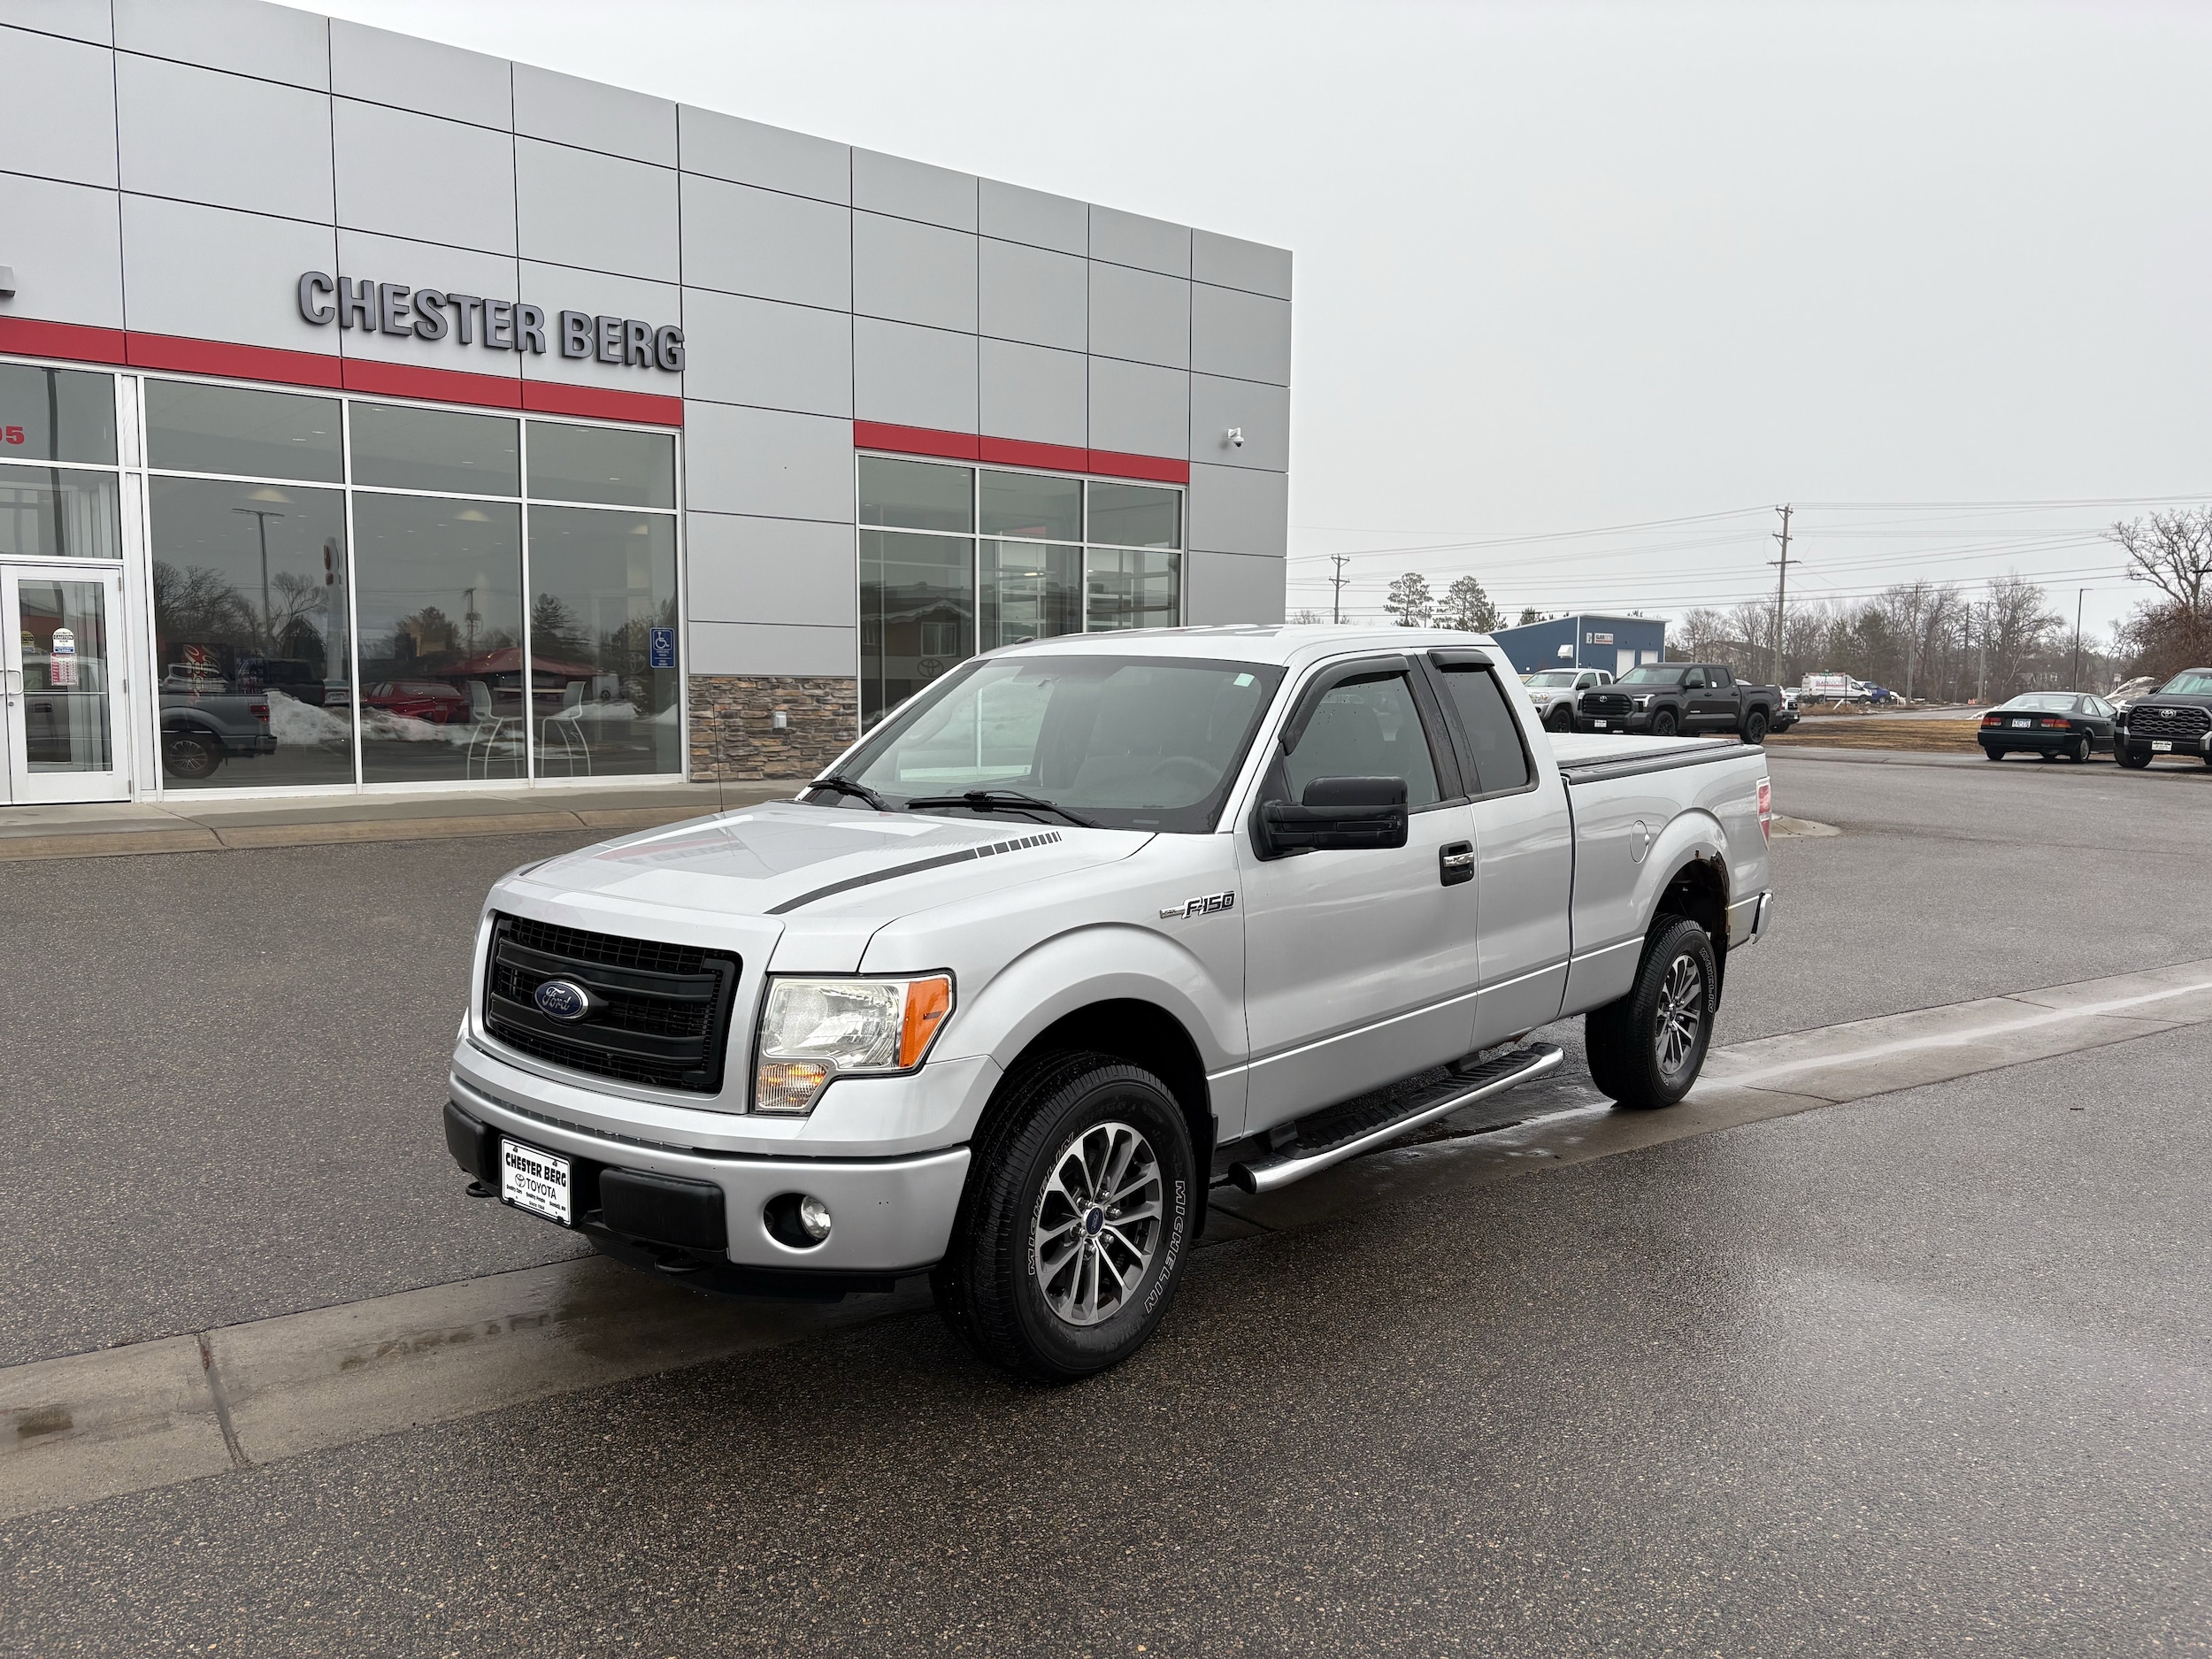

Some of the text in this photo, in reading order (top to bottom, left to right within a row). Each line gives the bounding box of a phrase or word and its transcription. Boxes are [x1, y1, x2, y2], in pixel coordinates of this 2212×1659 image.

[298, 271, 686, 372] CHESTER BERG
[0, 426, 25, 445] 5
[541, 986, 572, 1010] Ford
[1698, 947, 1715, 1014] MICHELIN
[505, 1152, 567, 1187] CHESTER BERG
[526, 1178, 557, 1200] TOYOTA
[1144, 1179, 1187, 1315] MICHELIN
